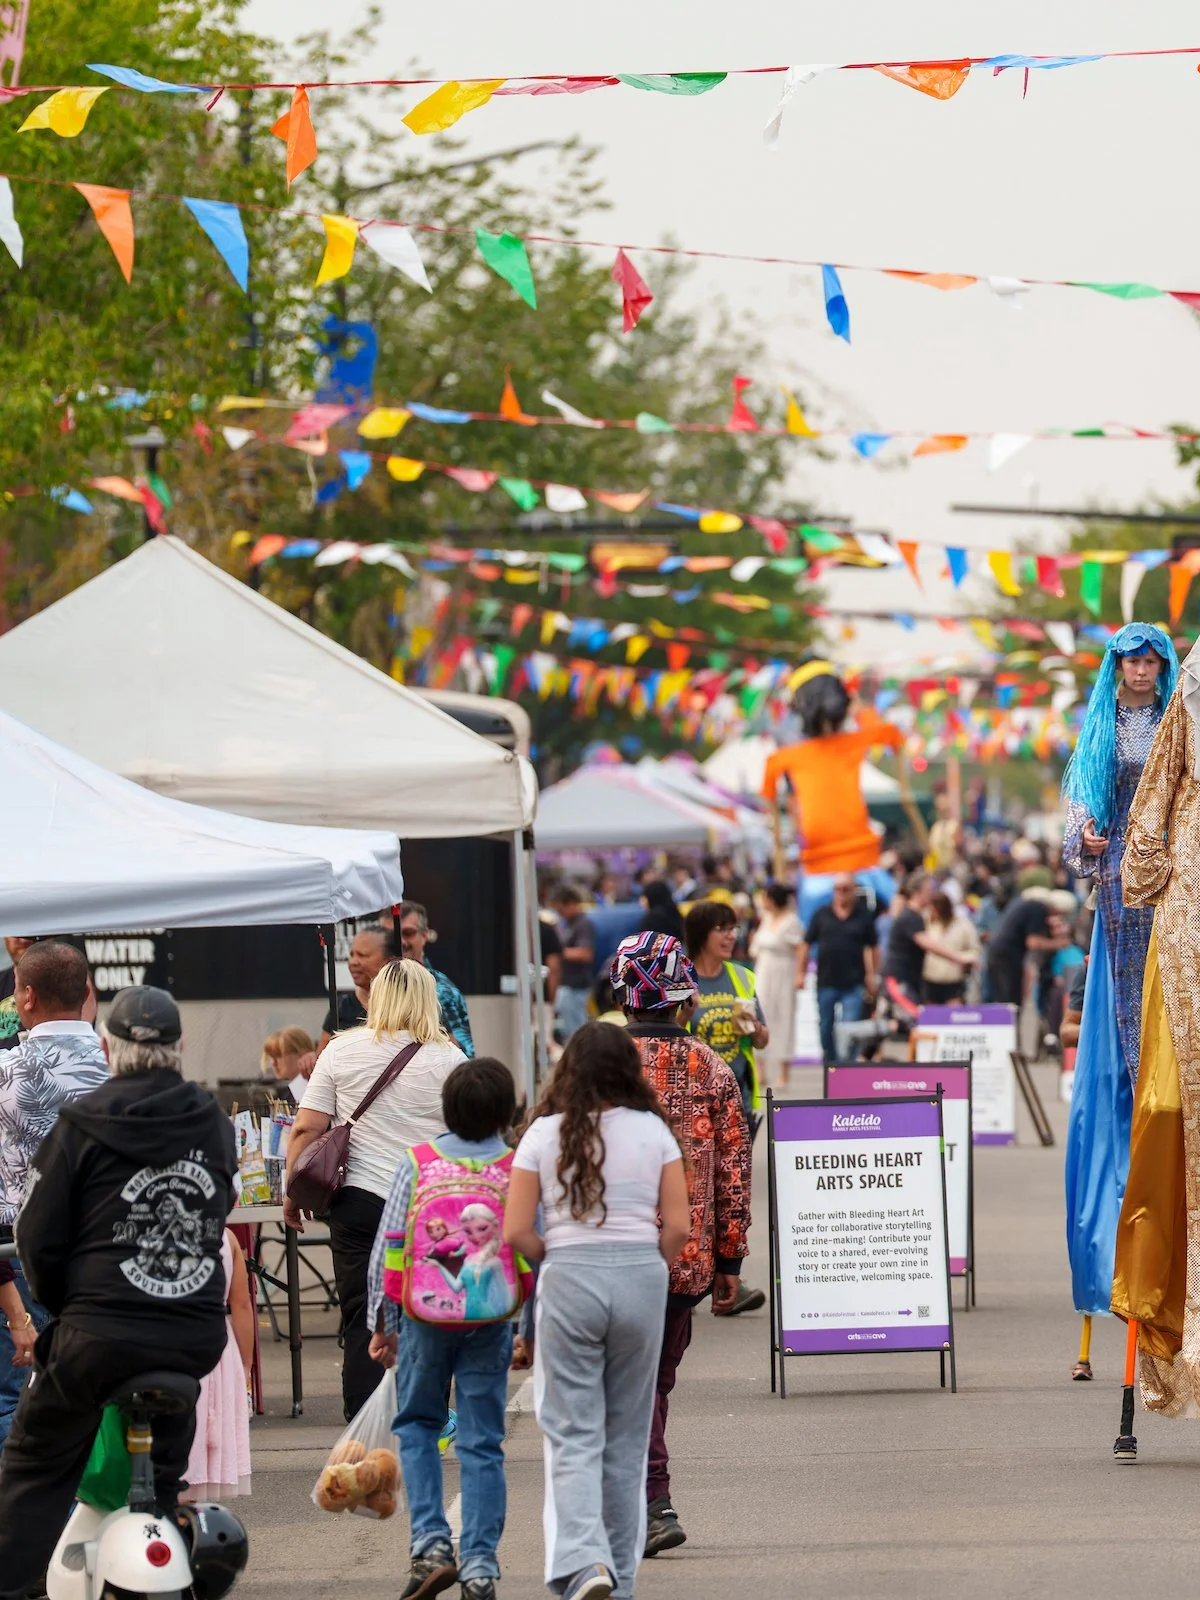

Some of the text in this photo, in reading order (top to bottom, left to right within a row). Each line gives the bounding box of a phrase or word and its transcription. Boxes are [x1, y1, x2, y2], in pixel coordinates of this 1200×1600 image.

[84, 939, 156, 964] WATER
[94, 966, 147, 991] ONLY
[832, 1114, 881, 1127] Kaleido
[795, 1151, 923, 1170] BLEEDING HEART
[189, 1165, 212, 1193] RALLY
[816, 1173, 904, 1191] ARTS SPACE
[798, 1208, 925, 1221] Gather with Bleeding Heart Art
[791, 1220, 932, 1235] Space for collaborative storytelling
[793, 1234, 932, 1246] and zine-making! Contribute your
[797, 1249, 818, 1258] voice
[821, 1249, 829, 1257] to
[839, 1248, 870, 1258] shared,
[872, 1246, 929, 1257] ever-evolving
[798, 1258, 929, 1272] story or create your own zine in
[126, 1264, 212, 1296] SOUTH DAKOTA
[795, 1271, 933, 1284] this interactive, welcoming space.
